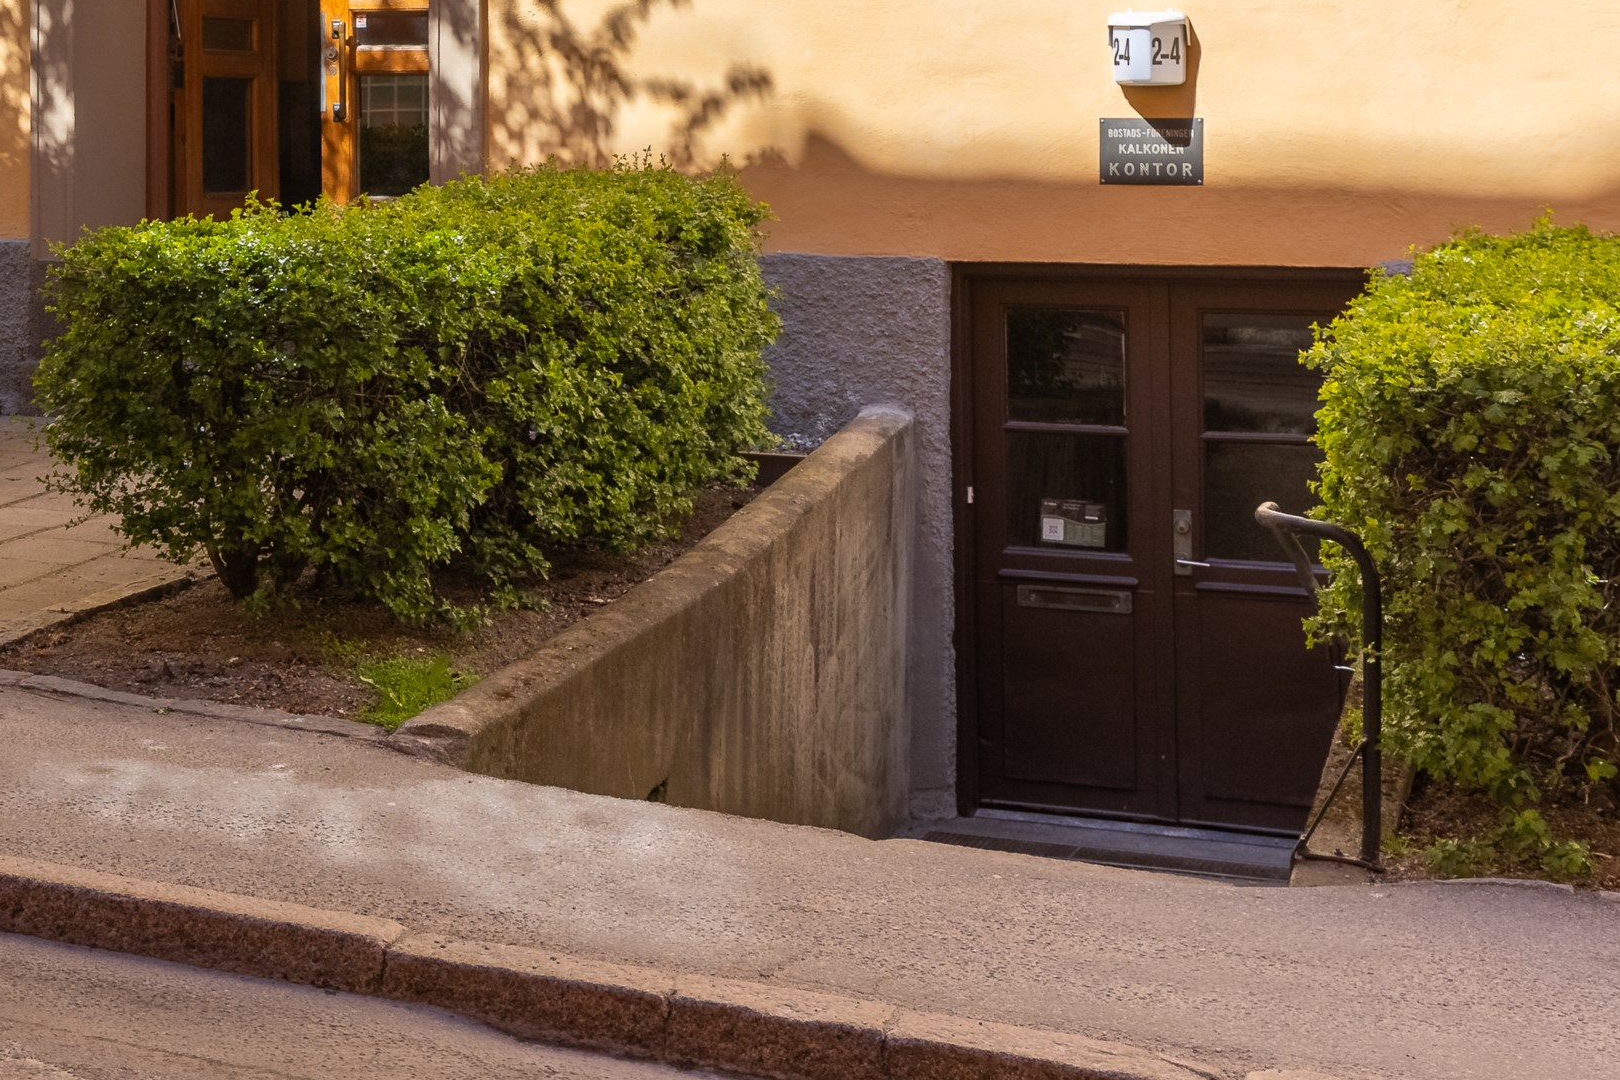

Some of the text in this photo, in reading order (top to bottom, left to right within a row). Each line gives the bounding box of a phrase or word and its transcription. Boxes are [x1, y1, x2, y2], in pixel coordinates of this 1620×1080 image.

[1113, 37, 1130, 66] 2-4
[1151, 37, 1180, 66] 2-4
[1118, 143, 1184, 155] KALKONEN
[1108, 162, 1193, 177] KONTOR
